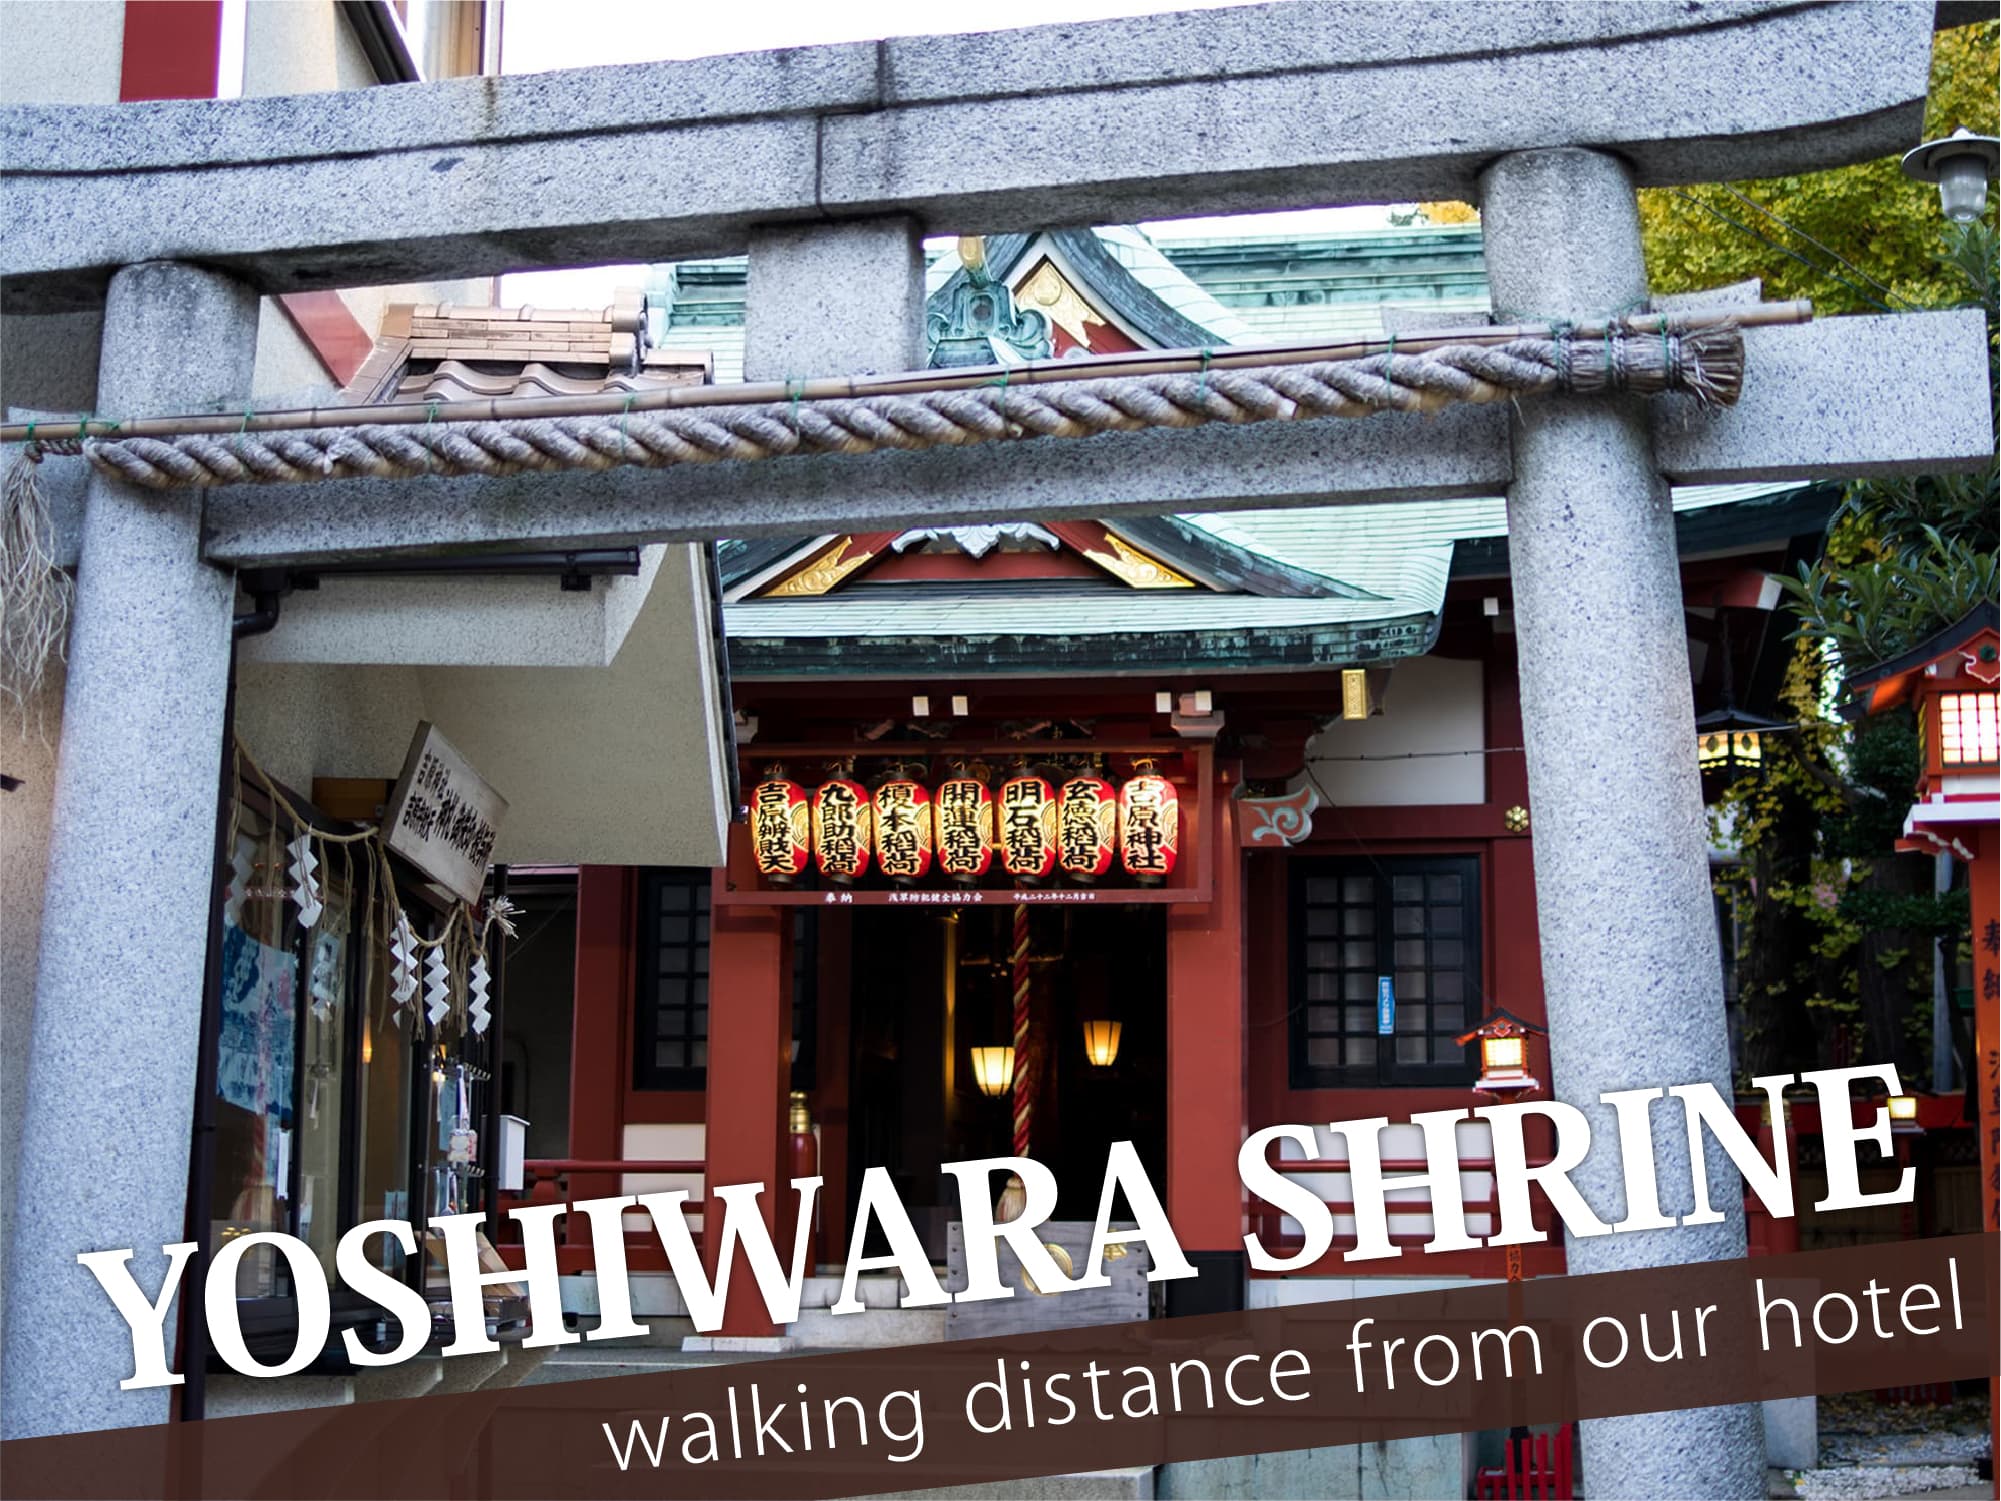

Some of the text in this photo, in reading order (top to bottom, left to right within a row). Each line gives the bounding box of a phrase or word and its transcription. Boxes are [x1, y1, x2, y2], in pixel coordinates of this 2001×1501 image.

[821, 783, 857, 872] 九郎助稲荷
[943, 782, 981, 871] 開運稲荷
[1005, 781, 1044, 870] 明石稲荷
[1126, 780, 1165, 869] 吉原神社
